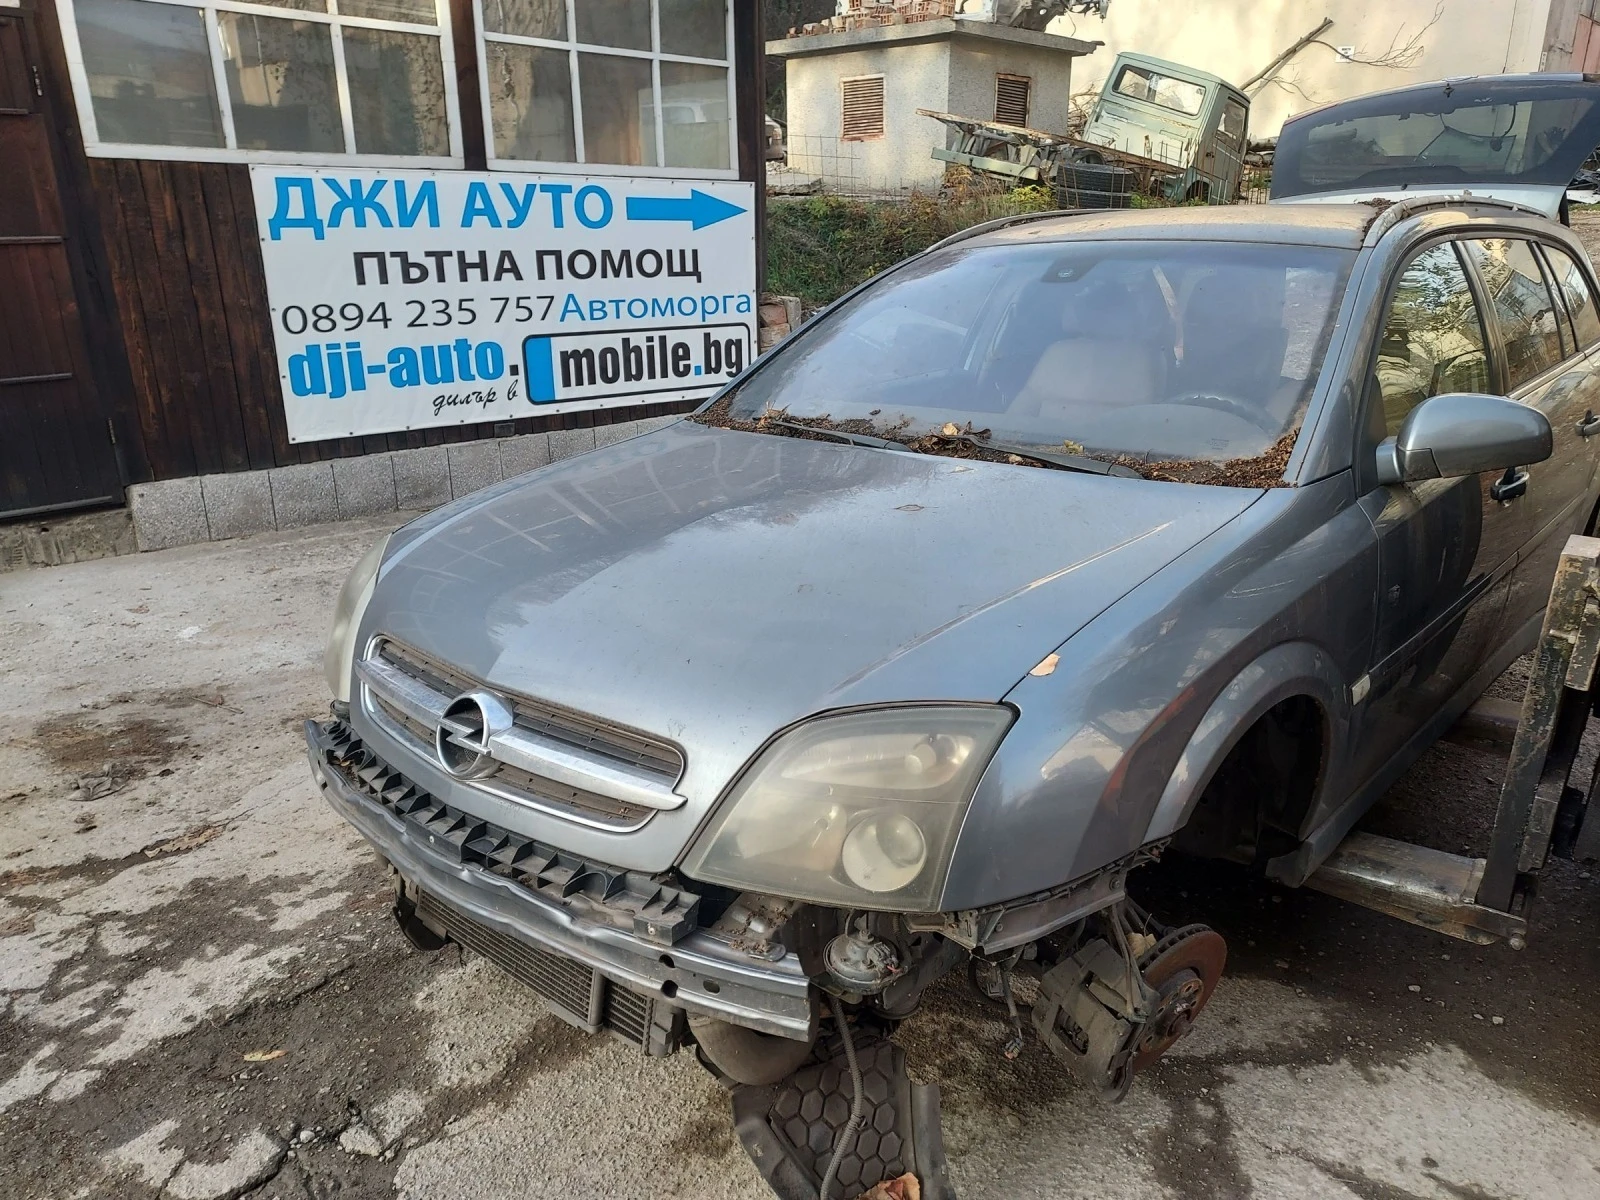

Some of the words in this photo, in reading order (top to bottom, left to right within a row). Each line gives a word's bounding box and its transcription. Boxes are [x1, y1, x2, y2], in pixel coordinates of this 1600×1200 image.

[268, 177, 440, 240] ДЖИ
[460, 182, 613, 229] АУТО
[353, 250, 523, 286] ПЪТНА
[535, 249, 702, 283] ПОМОЩ
[281, 302, 392, 334] 0894
[405, 298, 477, 328] 235
[490, 295, 555, 323] 757
[559, 293, 751, 322] Автоморга
[559, 332, 743, 388] mobile.bg
